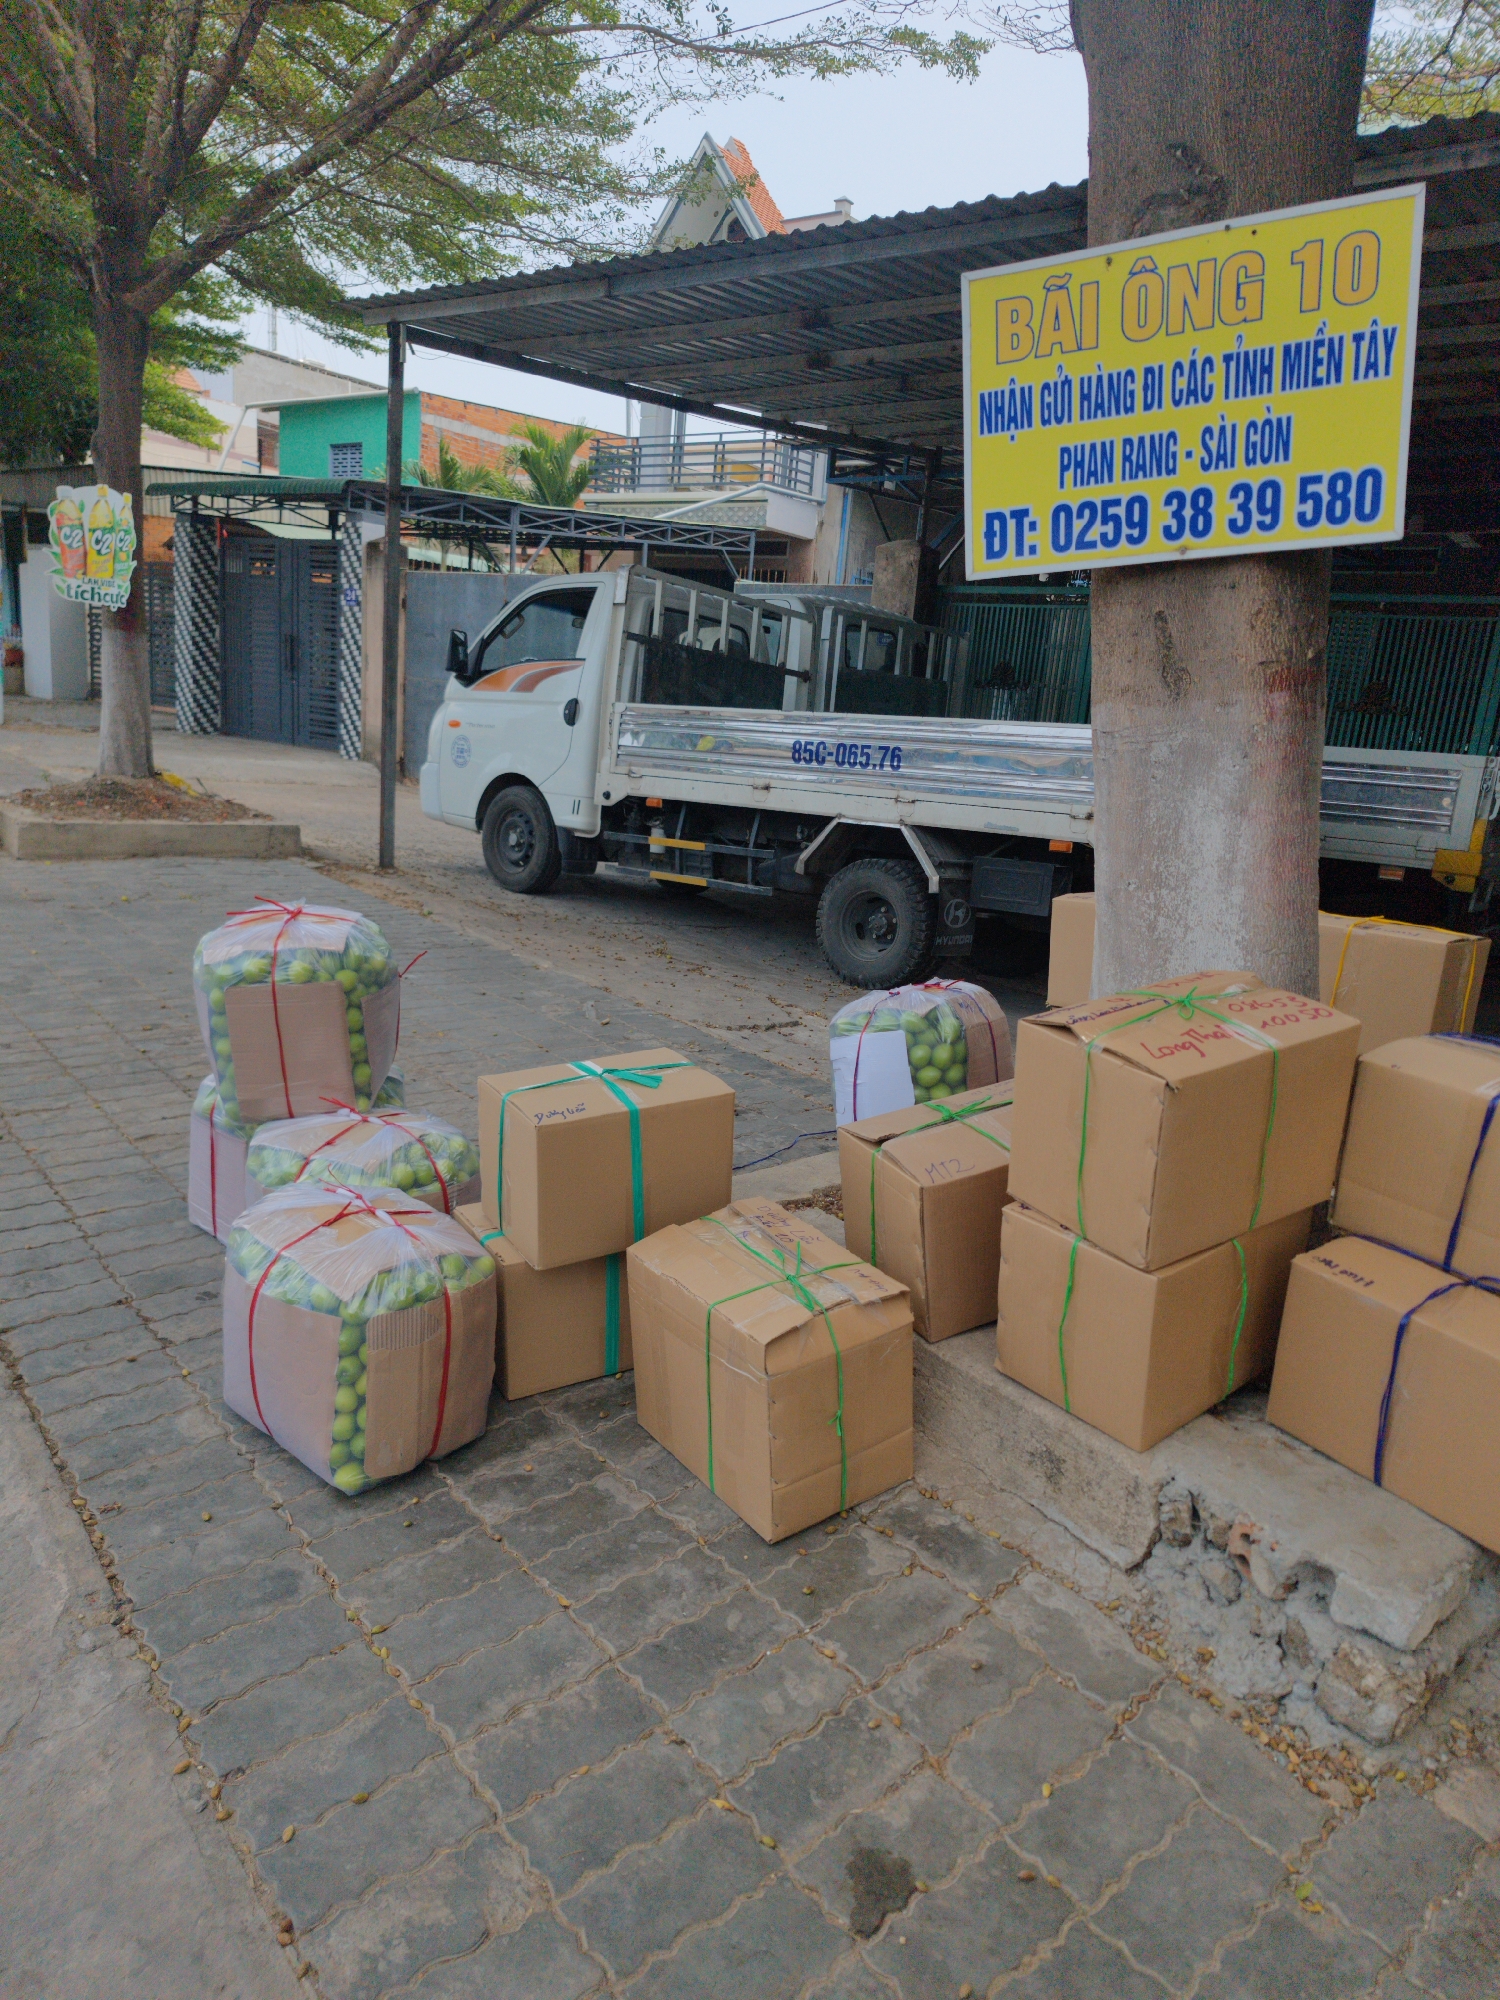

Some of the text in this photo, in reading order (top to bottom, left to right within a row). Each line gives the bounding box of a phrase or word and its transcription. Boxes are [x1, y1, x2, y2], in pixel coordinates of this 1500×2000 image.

[995, 230, 1381, 365] BÃI ÔNG 10
[979, 318, 1399, 441] NHẬN GỬI HÀNG ĐI CÁC TỈNH MIỀN TÂY
[1058, 441, 1114, 490] PHAN
[1122, 431, 1178, 482] RANG
[1200, 415, 1237, 472] SÀI
[1244, 406, 1293, 465] GÒN
[984, 467, 1383, 561] ĐT: 0259 38 39 580
[61, 526, 84, 549] C2
[91, 530, 113, 555] C2
[116, 531, 131, 551] C2
[66, 584, 126, 609] tích cực
[792, 740, 902, 772] 85C-065.76
